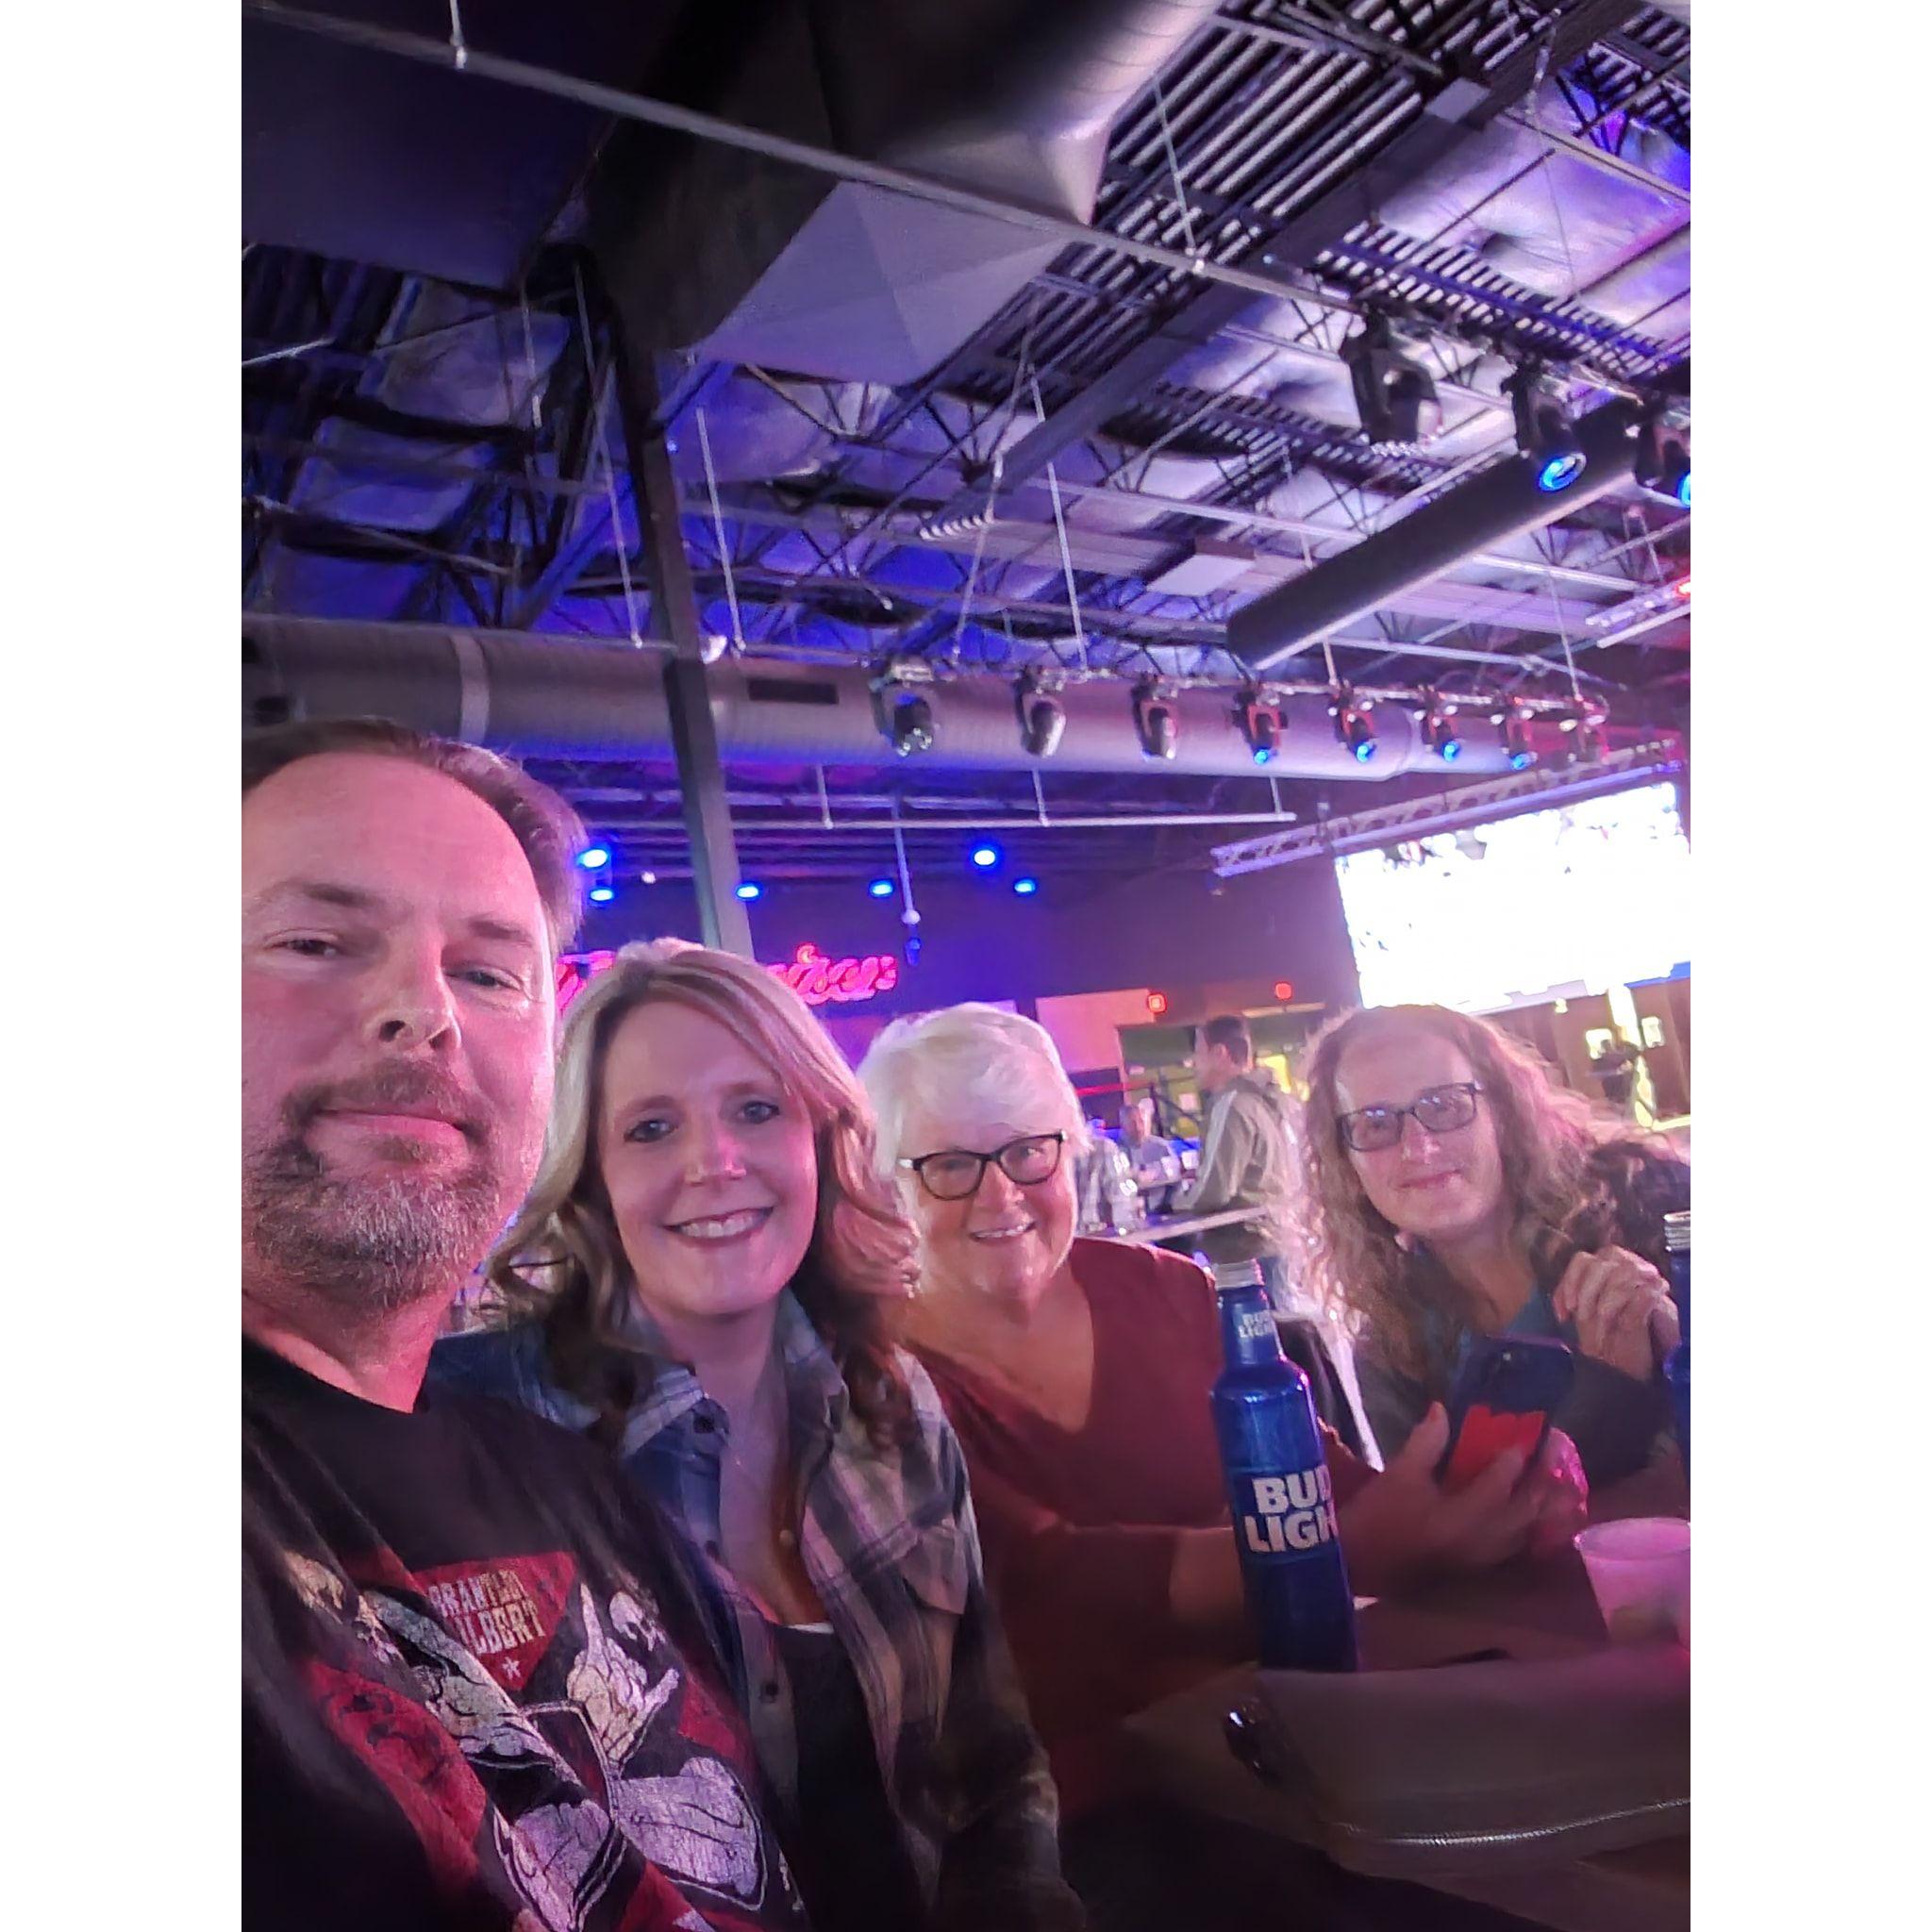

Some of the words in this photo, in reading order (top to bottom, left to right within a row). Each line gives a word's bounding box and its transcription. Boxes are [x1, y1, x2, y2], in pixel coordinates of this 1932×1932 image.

[1252, 1463, 1332, 1513] BUD
[1243, 1498, 1340, 1552] LIGH
[454, 1599, 545, 1654] ILBERT
